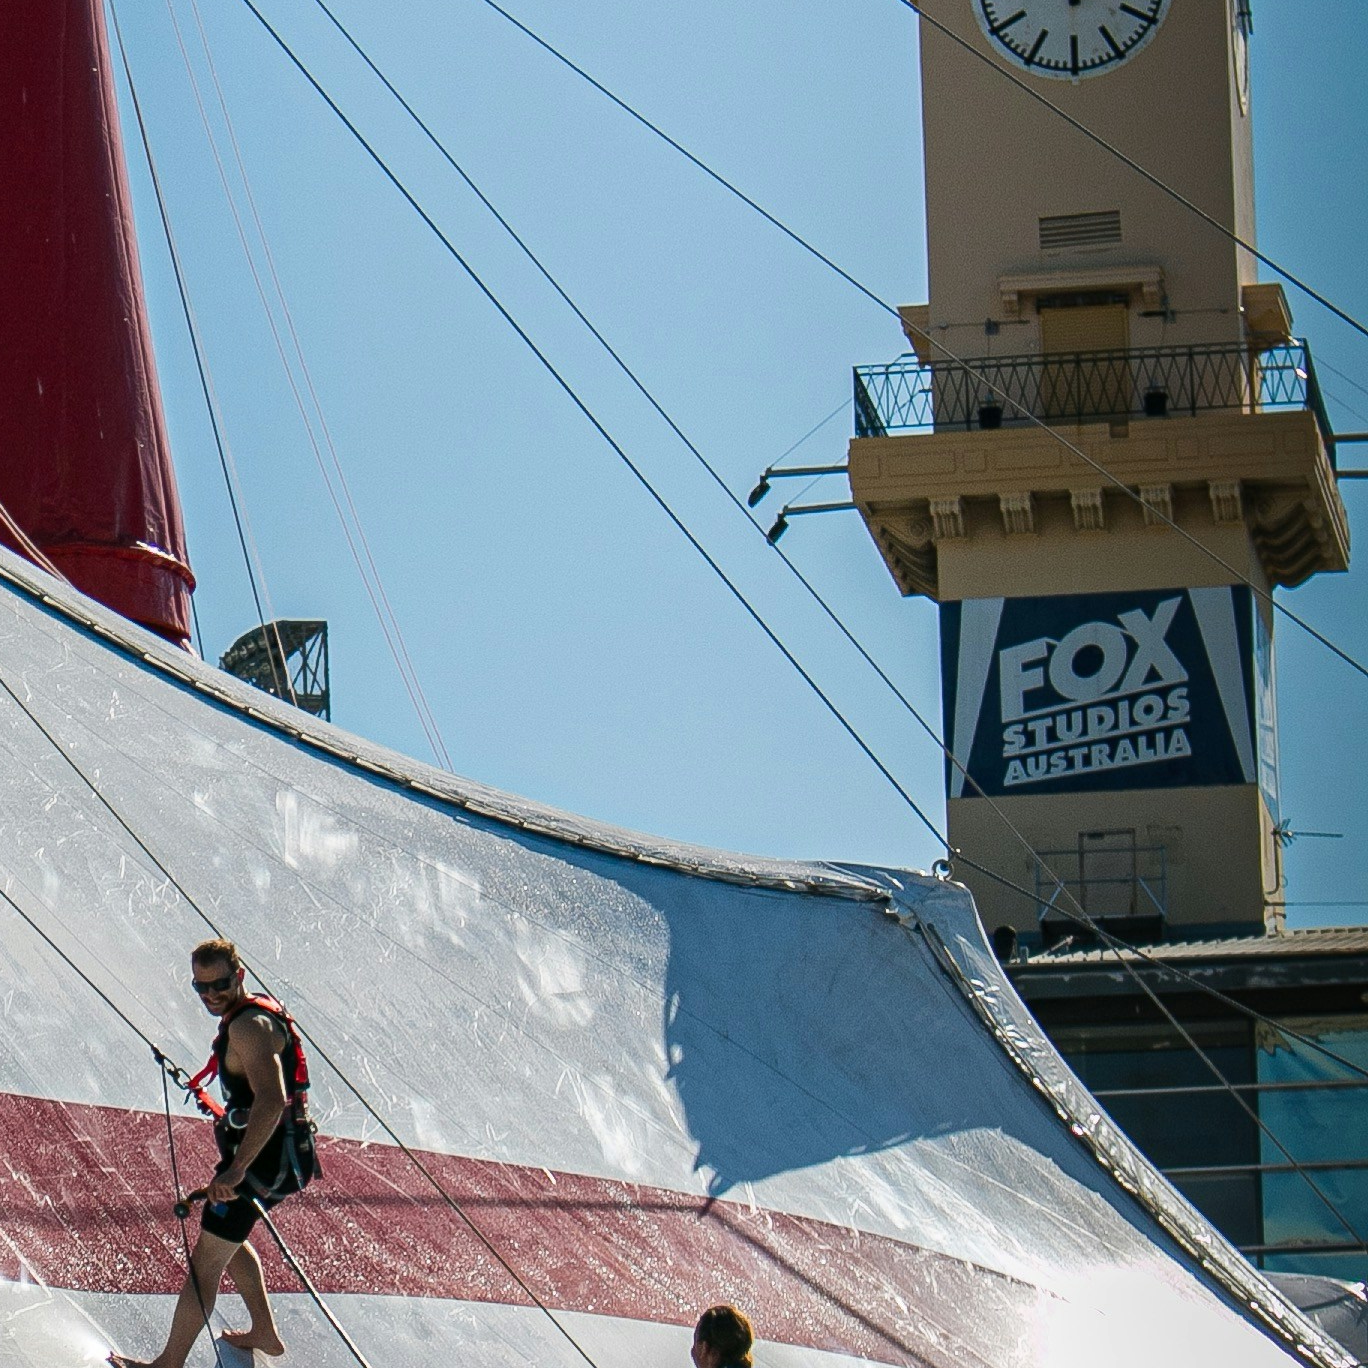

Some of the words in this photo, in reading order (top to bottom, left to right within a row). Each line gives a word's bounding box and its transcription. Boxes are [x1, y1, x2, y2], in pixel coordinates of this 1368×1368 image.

[999, 596, 1189, 724] FOX
[1003, 687, 1190, 757] STUDIOS
[1004, 729, 1192, 787] AUSTRALIA
